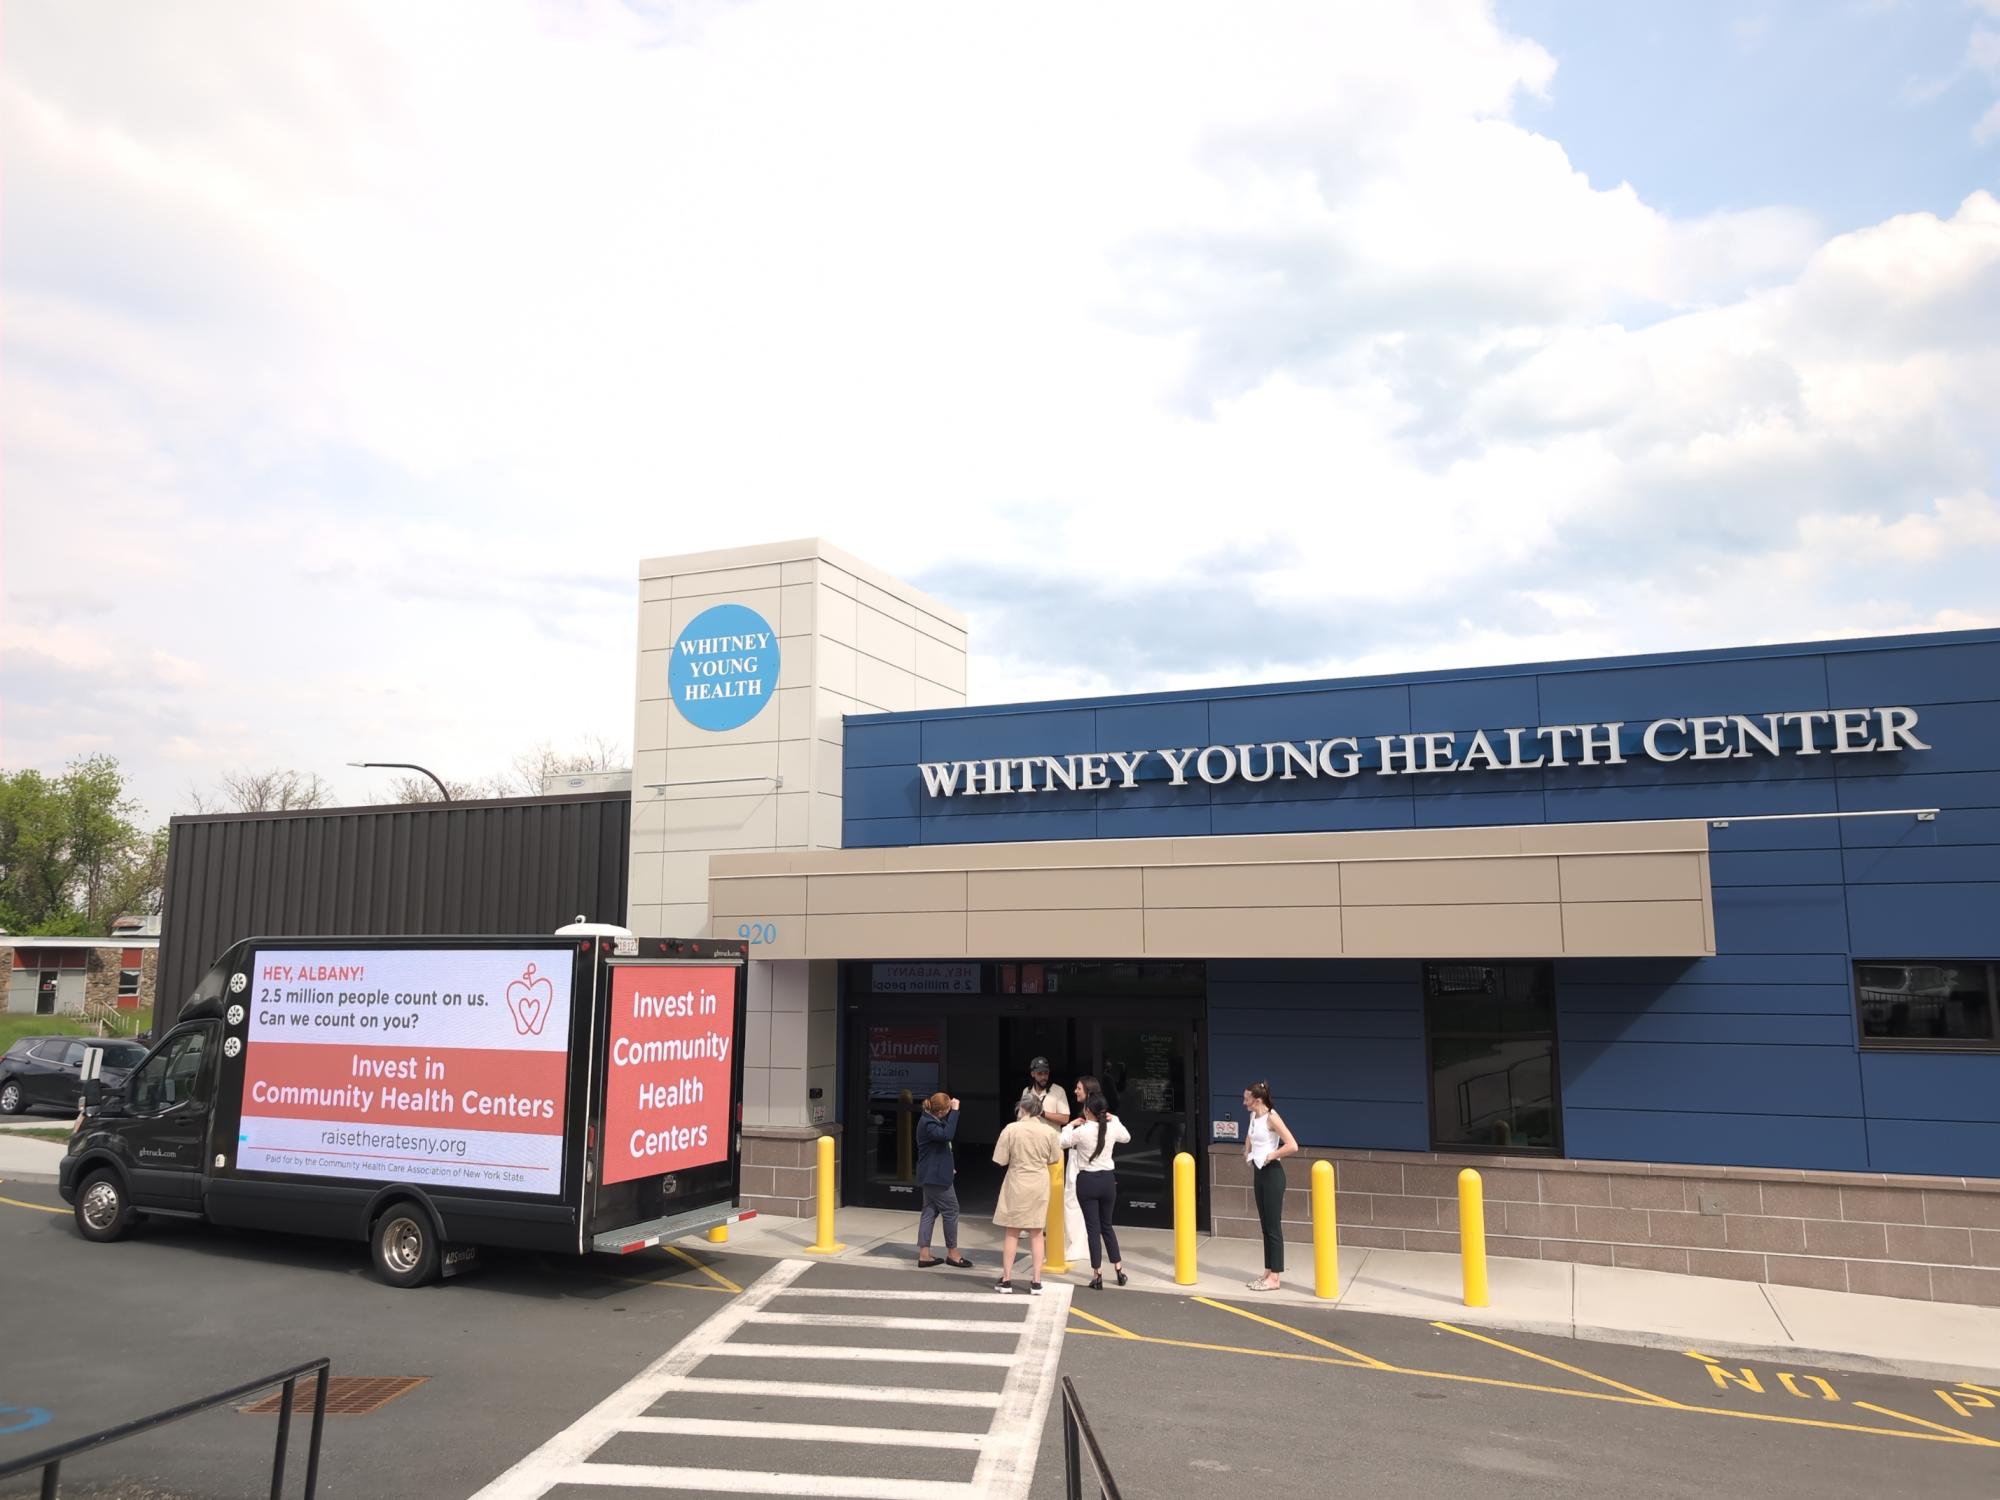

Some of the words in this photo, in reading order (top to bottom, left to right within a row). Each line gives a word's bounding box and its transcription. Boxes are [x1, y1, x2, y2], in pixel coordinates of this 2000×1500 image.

[680, 632, 770, 656] WHITNEY
[690, 656, 758, 677] YOUNG
[685, 679, 762, 700] HEALTH
[917, 750, 1148, 798] WHITNEY
[1157, 737, 1363, 786] YOUNG
[1375, 722, 1628, 776] HEALTH
[1643, 706, 1932, 763] CENTER
[738, 923, 778, 945] 920
[263, 966, 293, 984] HEY,
[298, 966, 364, 982] ALBANY!
[260, 988, 281, 1003] 2.5
[286, 988, 334, 1004] million
[338, 989, 389, 1007] people
[394, 990, 437, 1006] count
[442, 993, 461, 1006] on
[467, 993, 488, 1007] us.
[634, 991, 694, 1019] Invest
[700, 988, 716, 1015] in
[259, 1010, 285, 1026] Can
[290, 1014, 309, 1027] we
[314, 1012, 355, 1028] count
[360, 1015, 378, 1028] on
[383, 1013, 419, 1031] you?
[613, 1031, 730, 1067] Community
[352, 1053, 417, 1080] Invest
[425, 1056, 444, 1081] in
[252, 1080, 374, 1113] Community
[381, 1086, 454, 1113] Health
[462, 1090, 554, 1119] Centers
[639, 1075, 704, 1111] Health
[321, 1128, 467, 1157] raisetheratesny.org
[630, 1124, 708, 1159] Centers
[265, 1153, 281, 1164] Paid
[283, 1154, 293, 1164] for
[294, 1156, 304, 1167] by
[305, 1156, 317, 1166] the
[318, 1157, 360, 1171] Community
[362, 1161, 386, 1173] Health
[387, 1163, 405, 1173] Care
[406, 1164, 450, 1177] Association
[453, 1168, 461, 1177] of
[463, 1169, 480, 1179] New
[483, 1170, 501, 1181] York
[503, 1171, 525, 1183] State
[1705, 1364, 1841, 1402] NO
